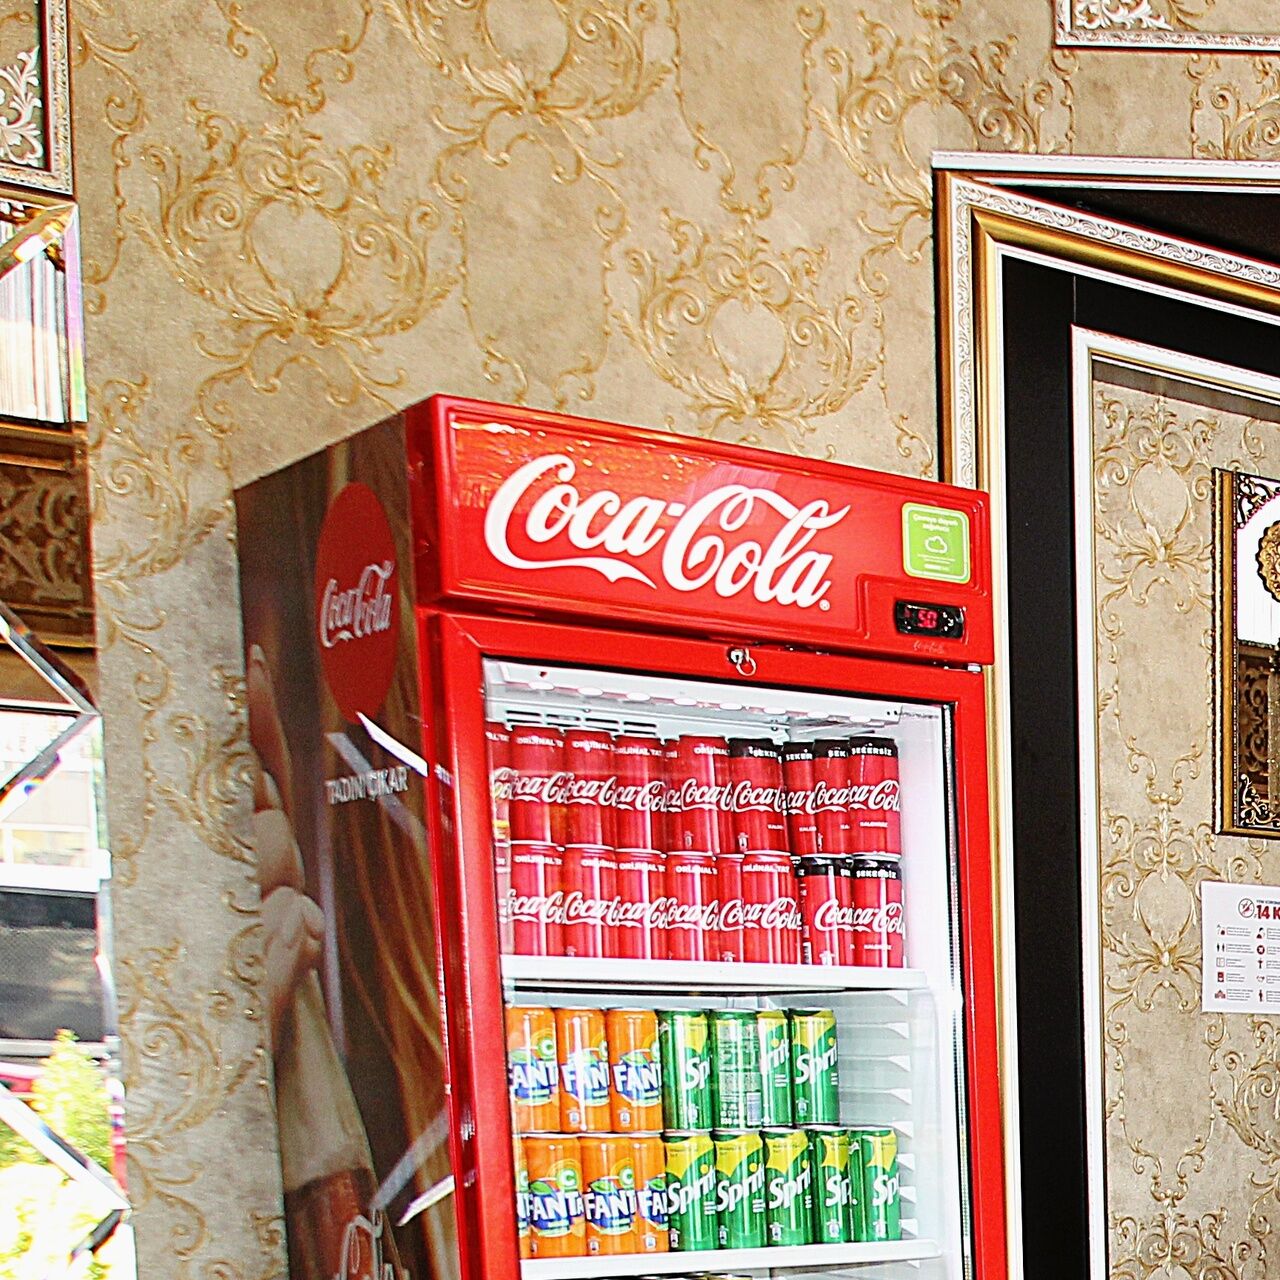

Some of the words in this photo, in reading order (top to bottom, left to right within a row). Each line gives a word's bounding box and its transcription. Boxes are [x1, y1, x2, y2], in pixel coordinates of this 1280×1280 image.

[484, 454, 851, 608] Coca-Cola
[321, 560, 395, 649] Coca-Cola
[1256, 904, 1271, 920] 14
[510, 1059, 558, 1090] ANT
[562, 1061, 609, 1092] FANT
[612, 1061, 661, 1092] FANT
[584, 1189, 636, 1220] FANT
